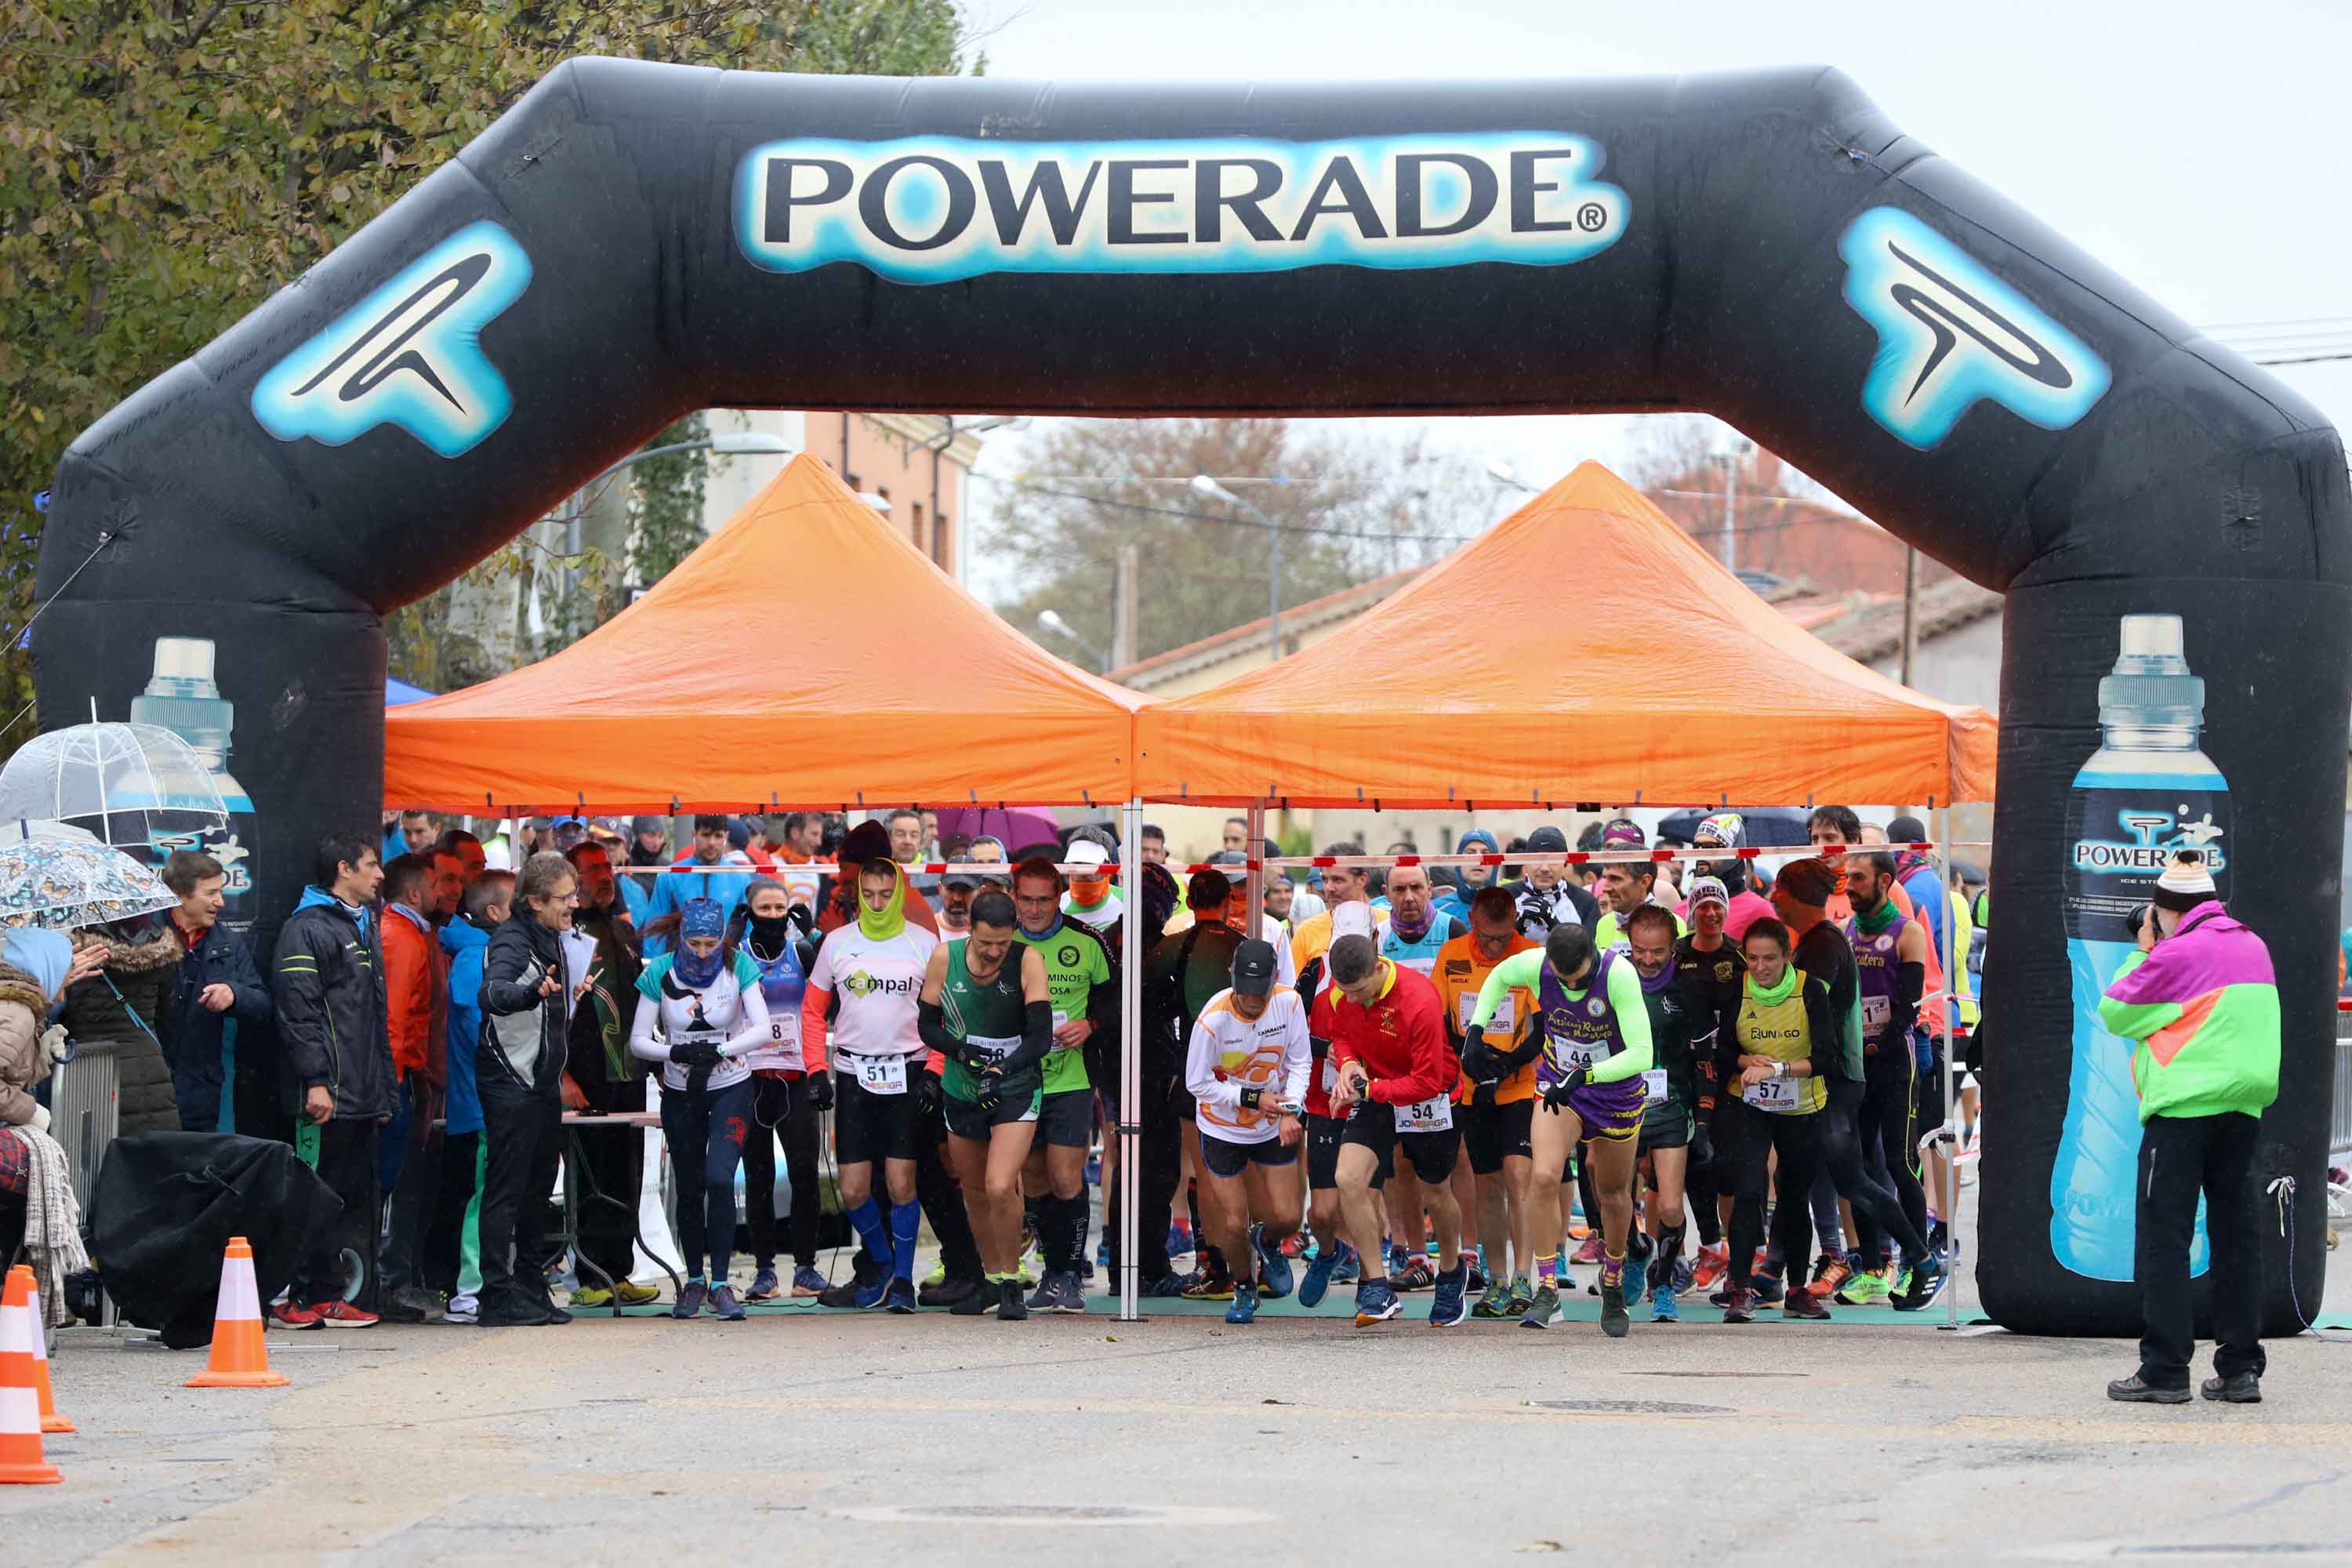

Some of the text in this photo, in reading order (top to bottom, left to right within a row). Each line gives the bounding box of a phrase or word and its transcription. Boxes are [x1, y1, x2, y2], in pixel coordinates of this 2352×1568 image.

[848, 977, 913, 995] campal
[1570, 1051, 1593, 1065] 44
[867, 1065, 887, 1082] 51
[1759, 1082, 1780, 1099] 57
[1411, 1104, 1434, 1120] 54
